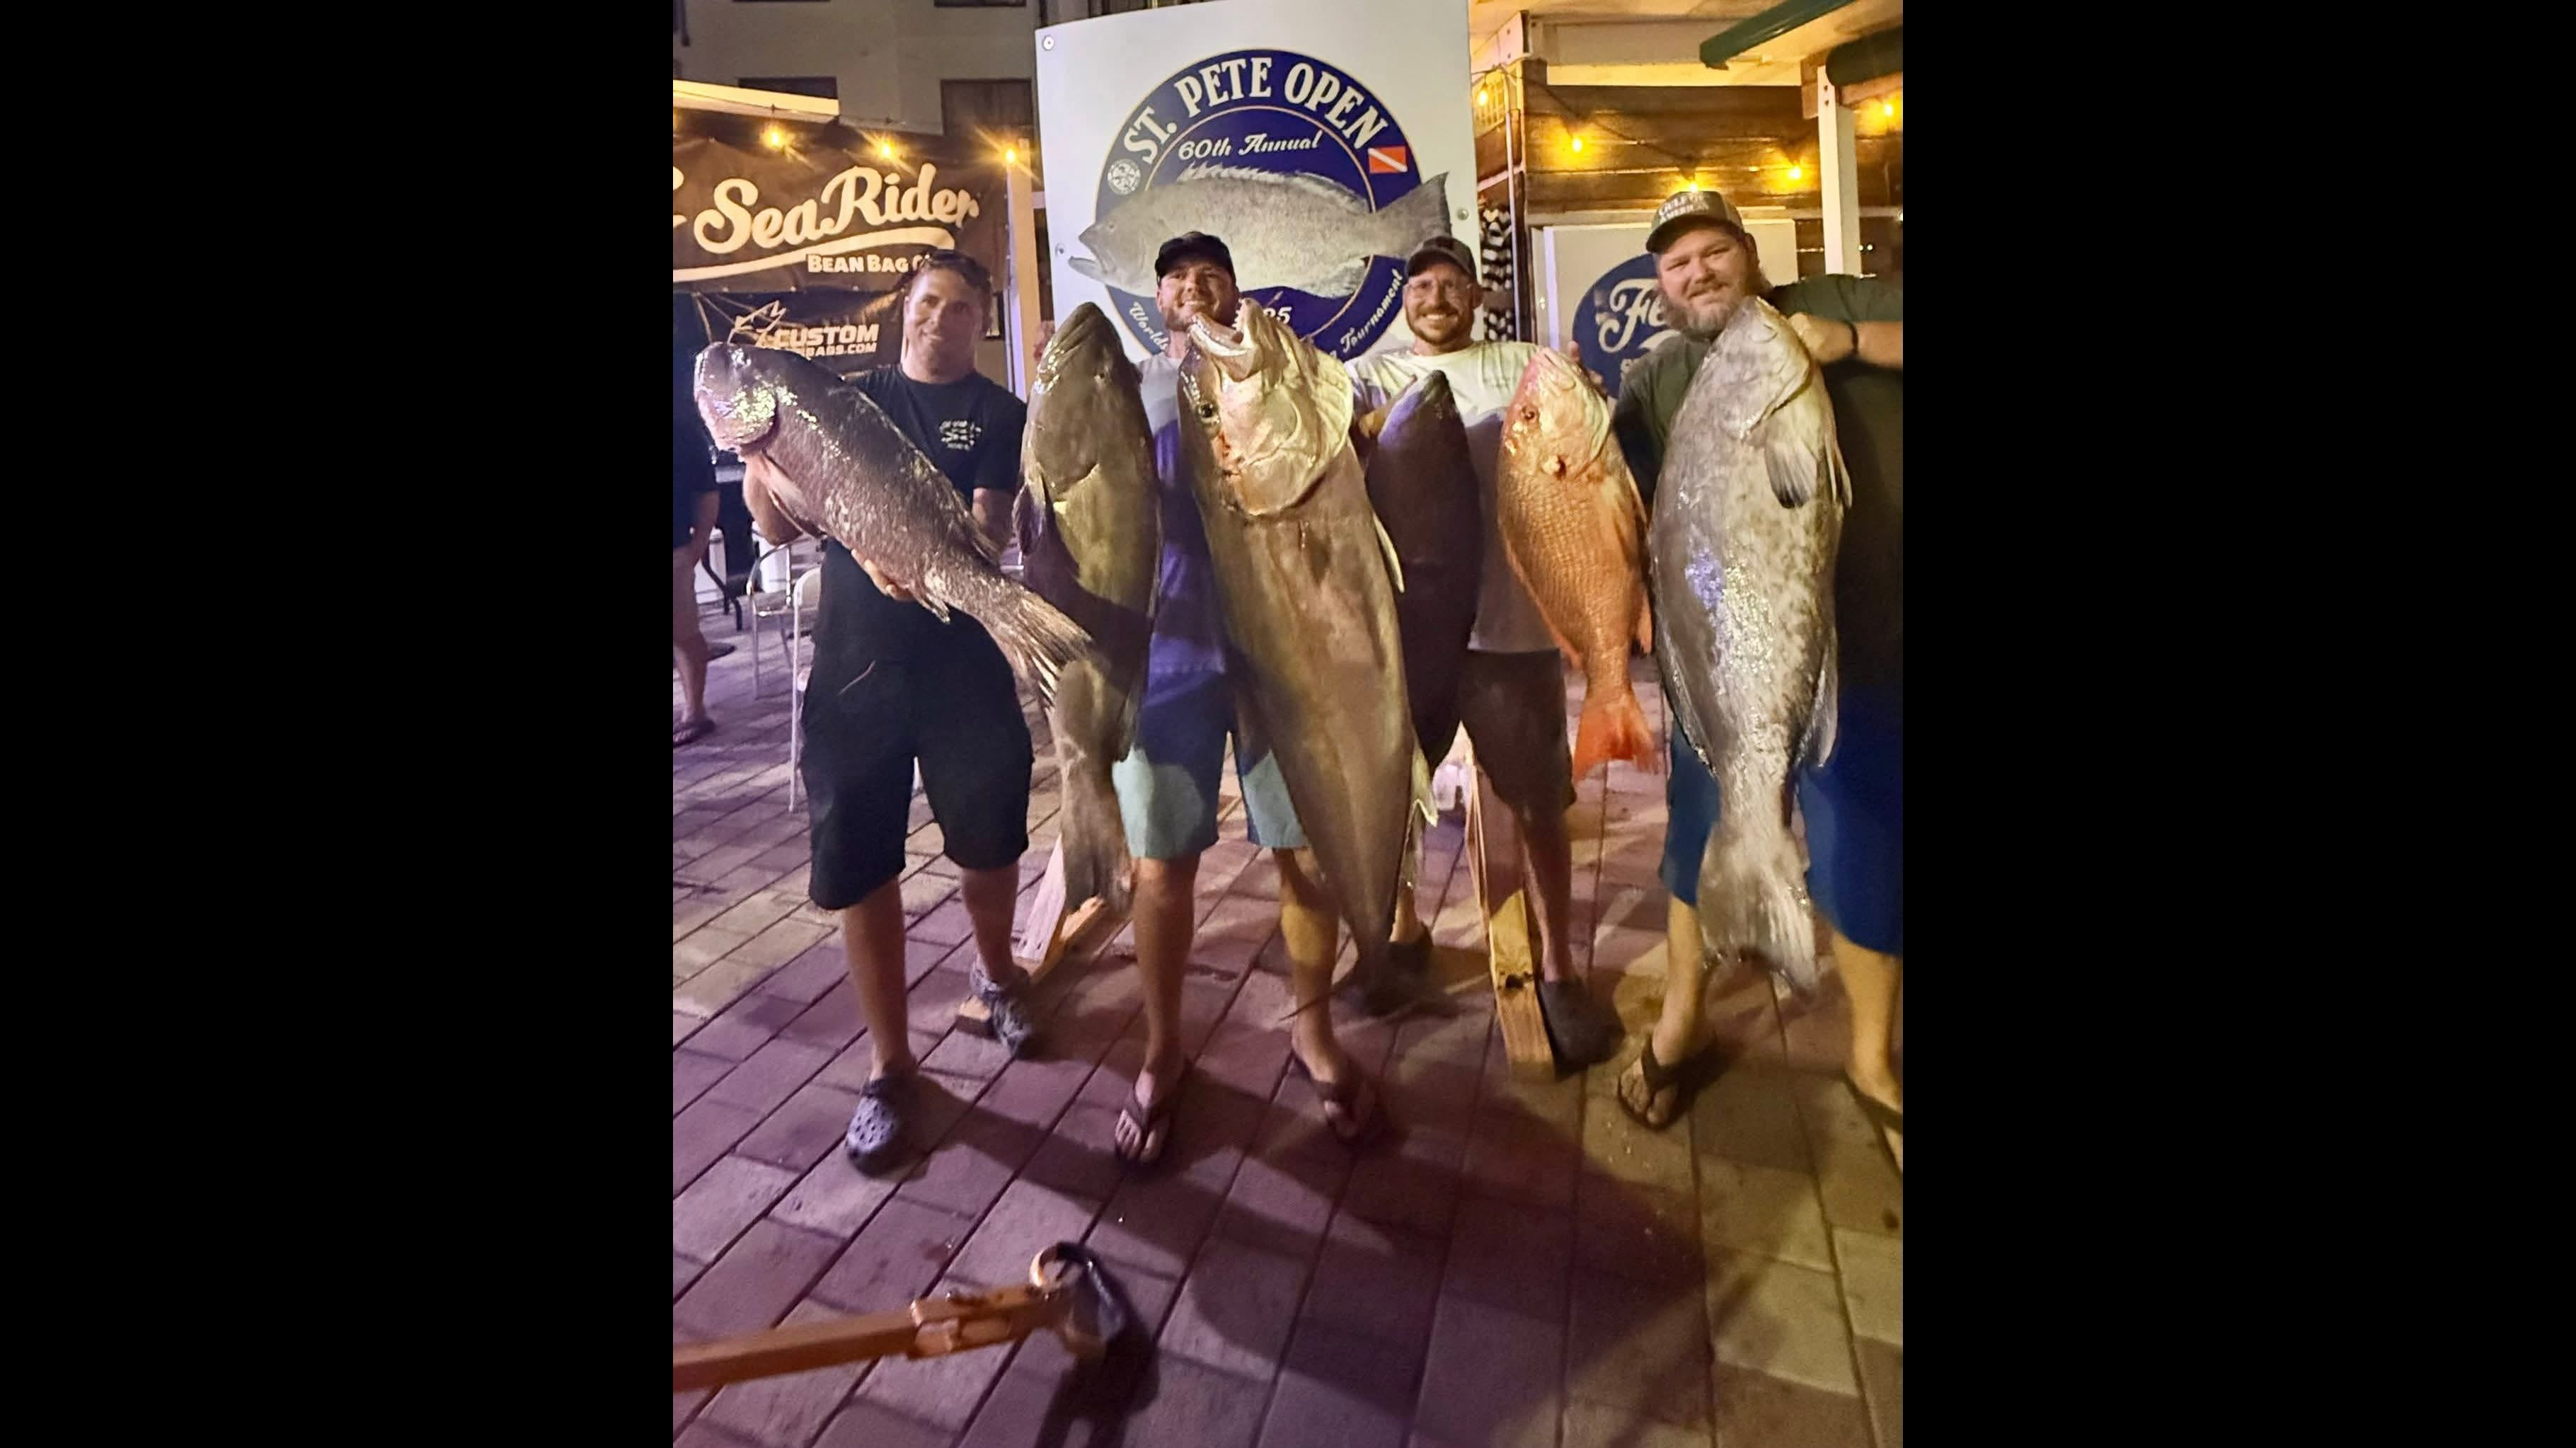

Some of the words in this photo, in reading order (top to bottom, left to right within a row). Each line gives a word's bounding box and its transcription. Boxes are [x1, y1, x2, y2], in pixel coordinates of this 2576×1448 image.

[1124, 105, 1177, 164] ST.
[1174, 57, 1272, 117] PETE
[1284, 63, 1388, 149] OPEN
[1178, 137, 1231, 160] 60th
[1238, 130, 1323, 156] Annual
[807, 254, 864, 272] BEAN
[867, 254, 909, 272] BAG
[1262, 306, 1292, 324] 25
[1340, 268, 1403, 353] Tournament
[774, 323, 880, 347] CUSTOM
[797, 343, 878, 358] BAGS.COM
